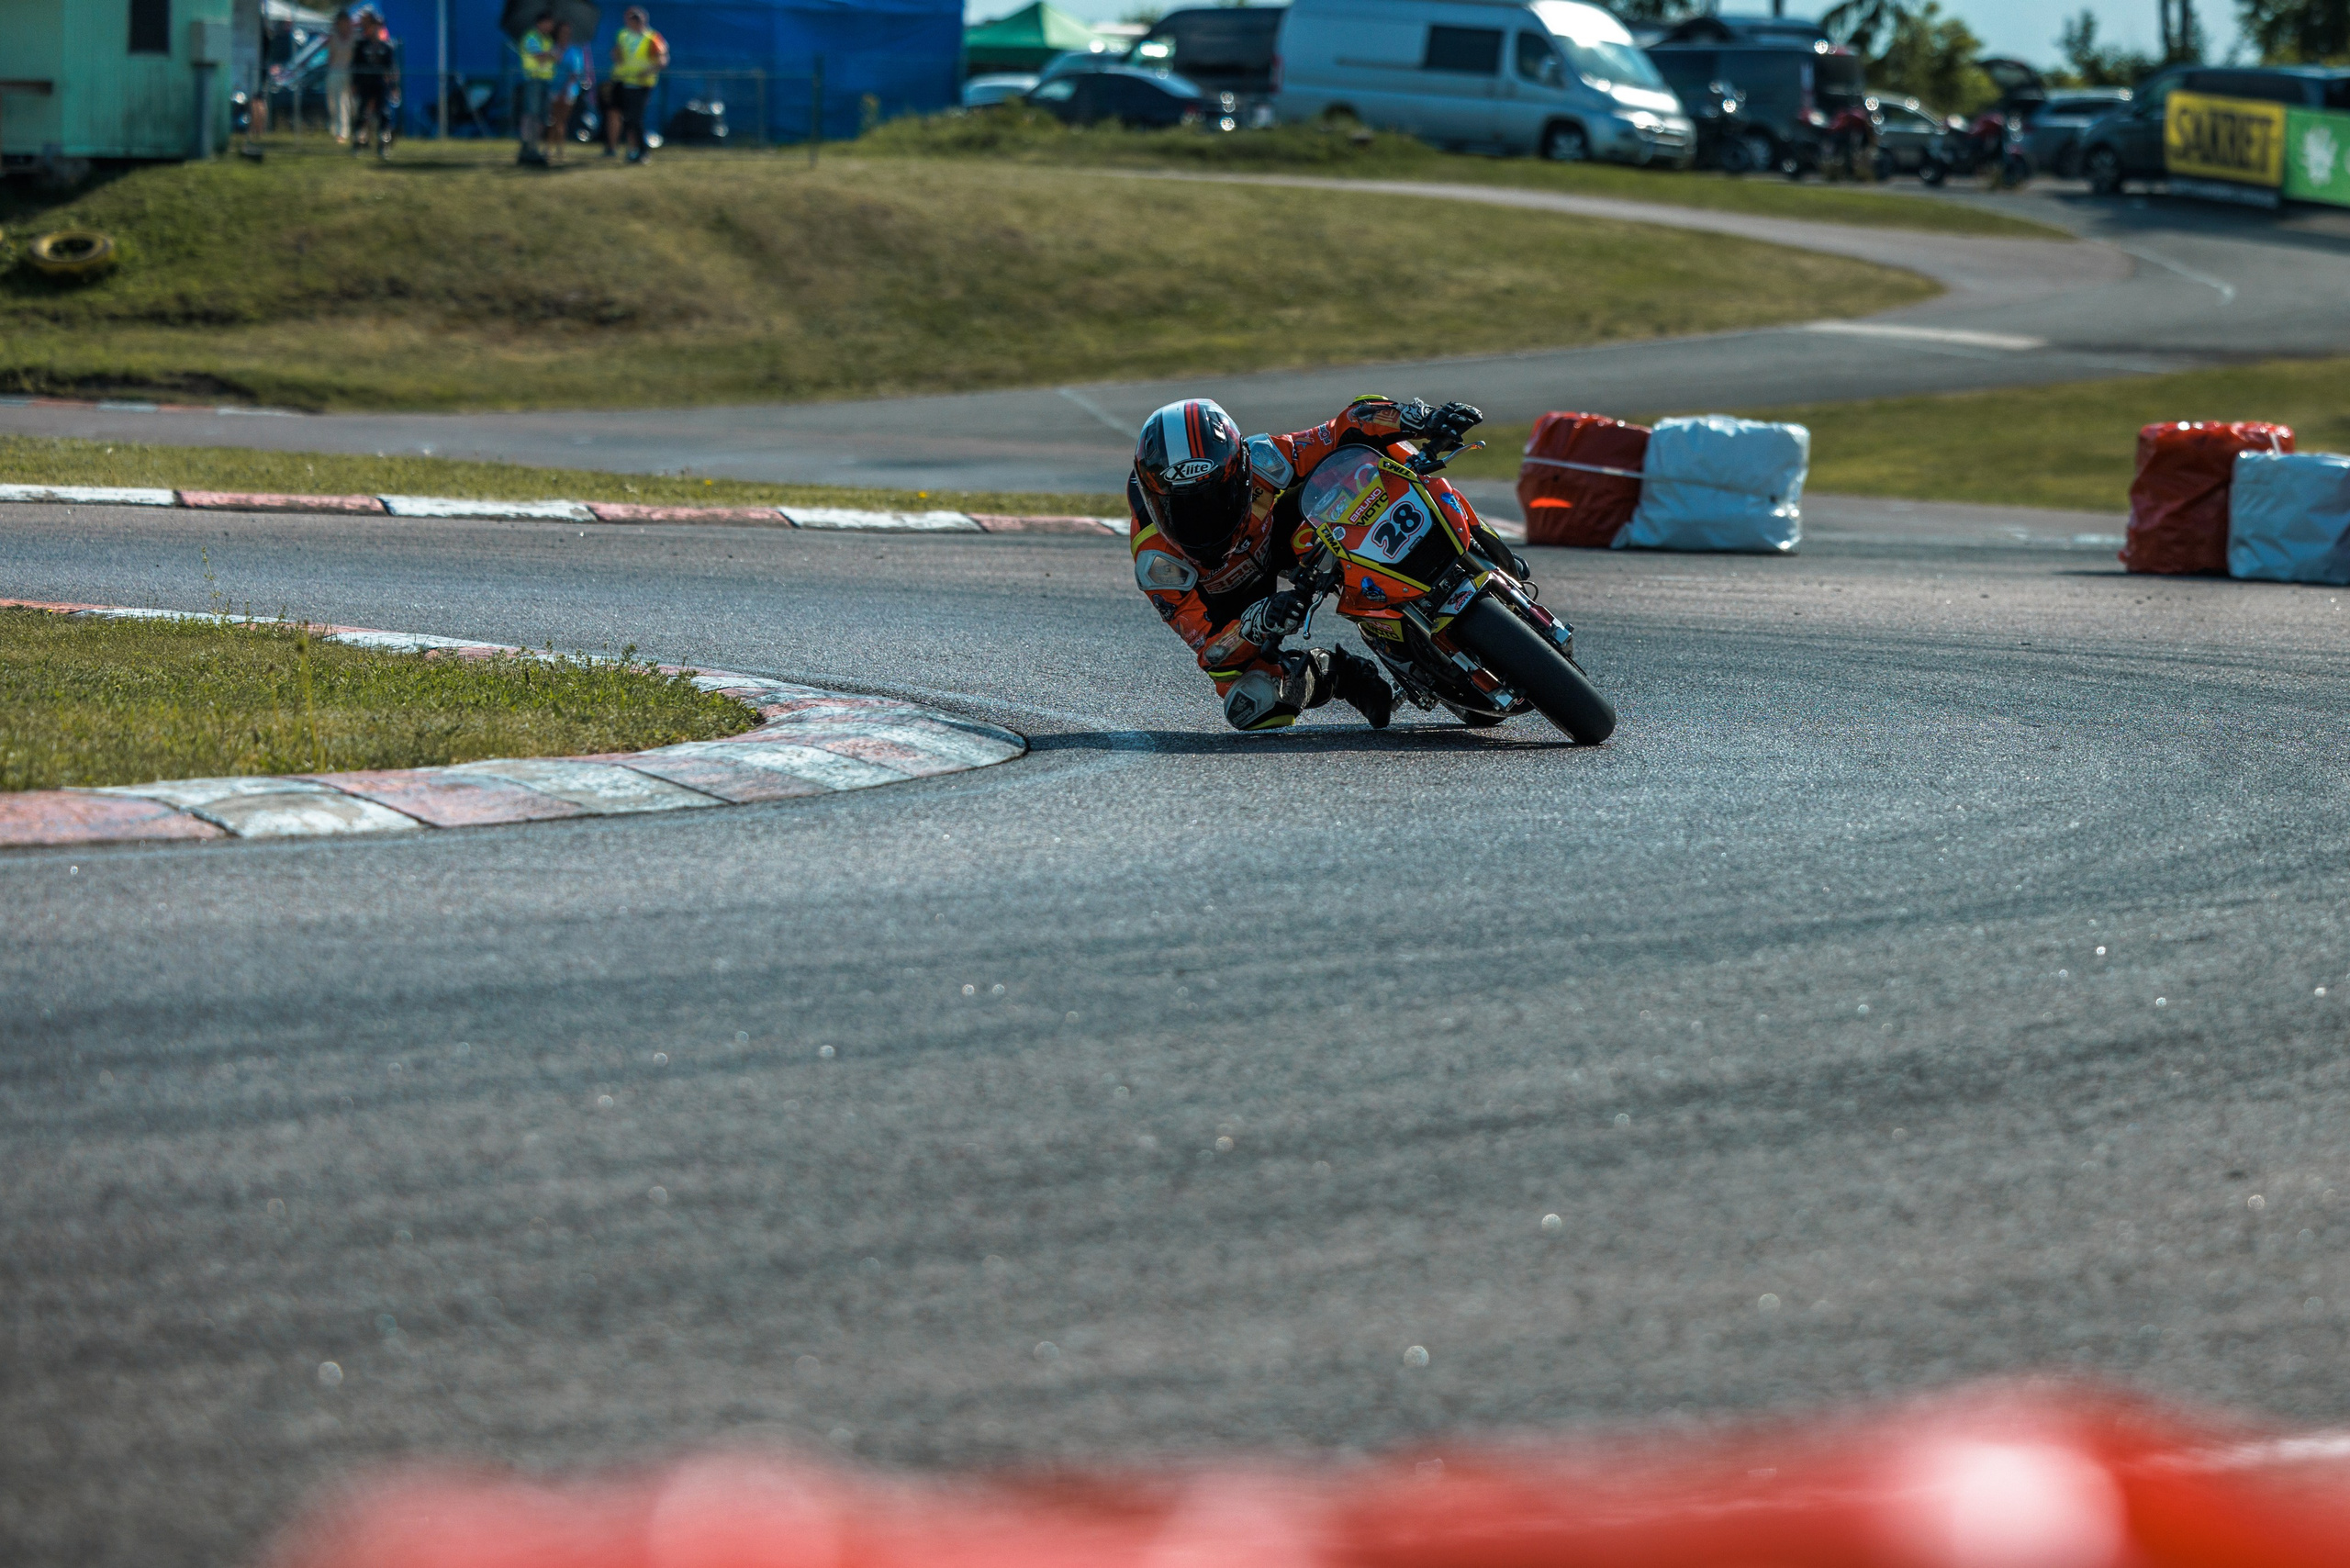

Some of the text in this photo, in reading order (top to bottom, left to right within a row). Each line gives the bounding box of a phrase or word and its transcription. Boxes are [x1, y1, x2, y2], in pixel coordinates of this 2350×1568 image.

[1170, 463, 1209, 480] X-lite
[1382, 460, 1411, 477] TIMA
[1349, 487, 1382, 523] BRUNO
[1356, 492, 1389, 526] MOTO
[1321, 524, 1342, 556] TIMA
[1373, 502, 1423, 557] 28
